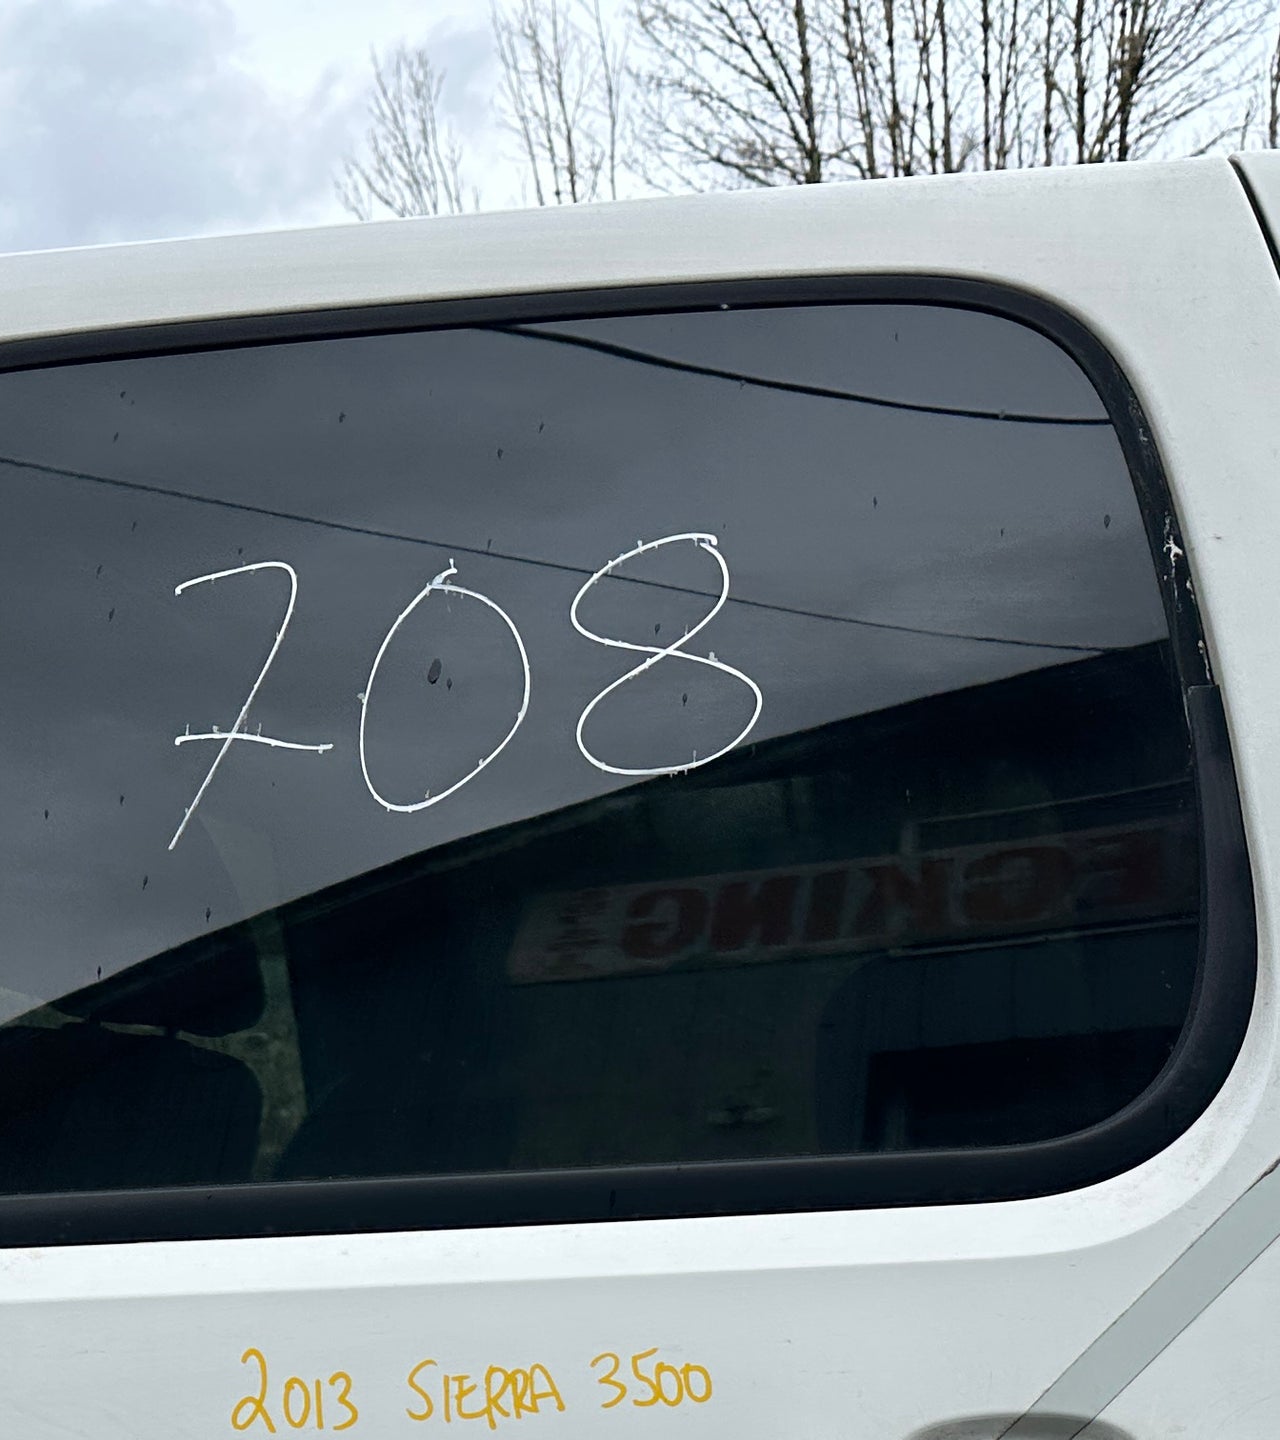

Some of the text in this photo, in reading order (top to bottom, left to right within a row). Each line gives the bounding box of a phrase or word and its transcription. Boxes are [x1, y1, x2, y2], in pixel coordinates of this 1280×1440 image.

[168, 532, 763, 850] 708
[231, 1347, 713, 1434] 2013 SIERRA 3500
